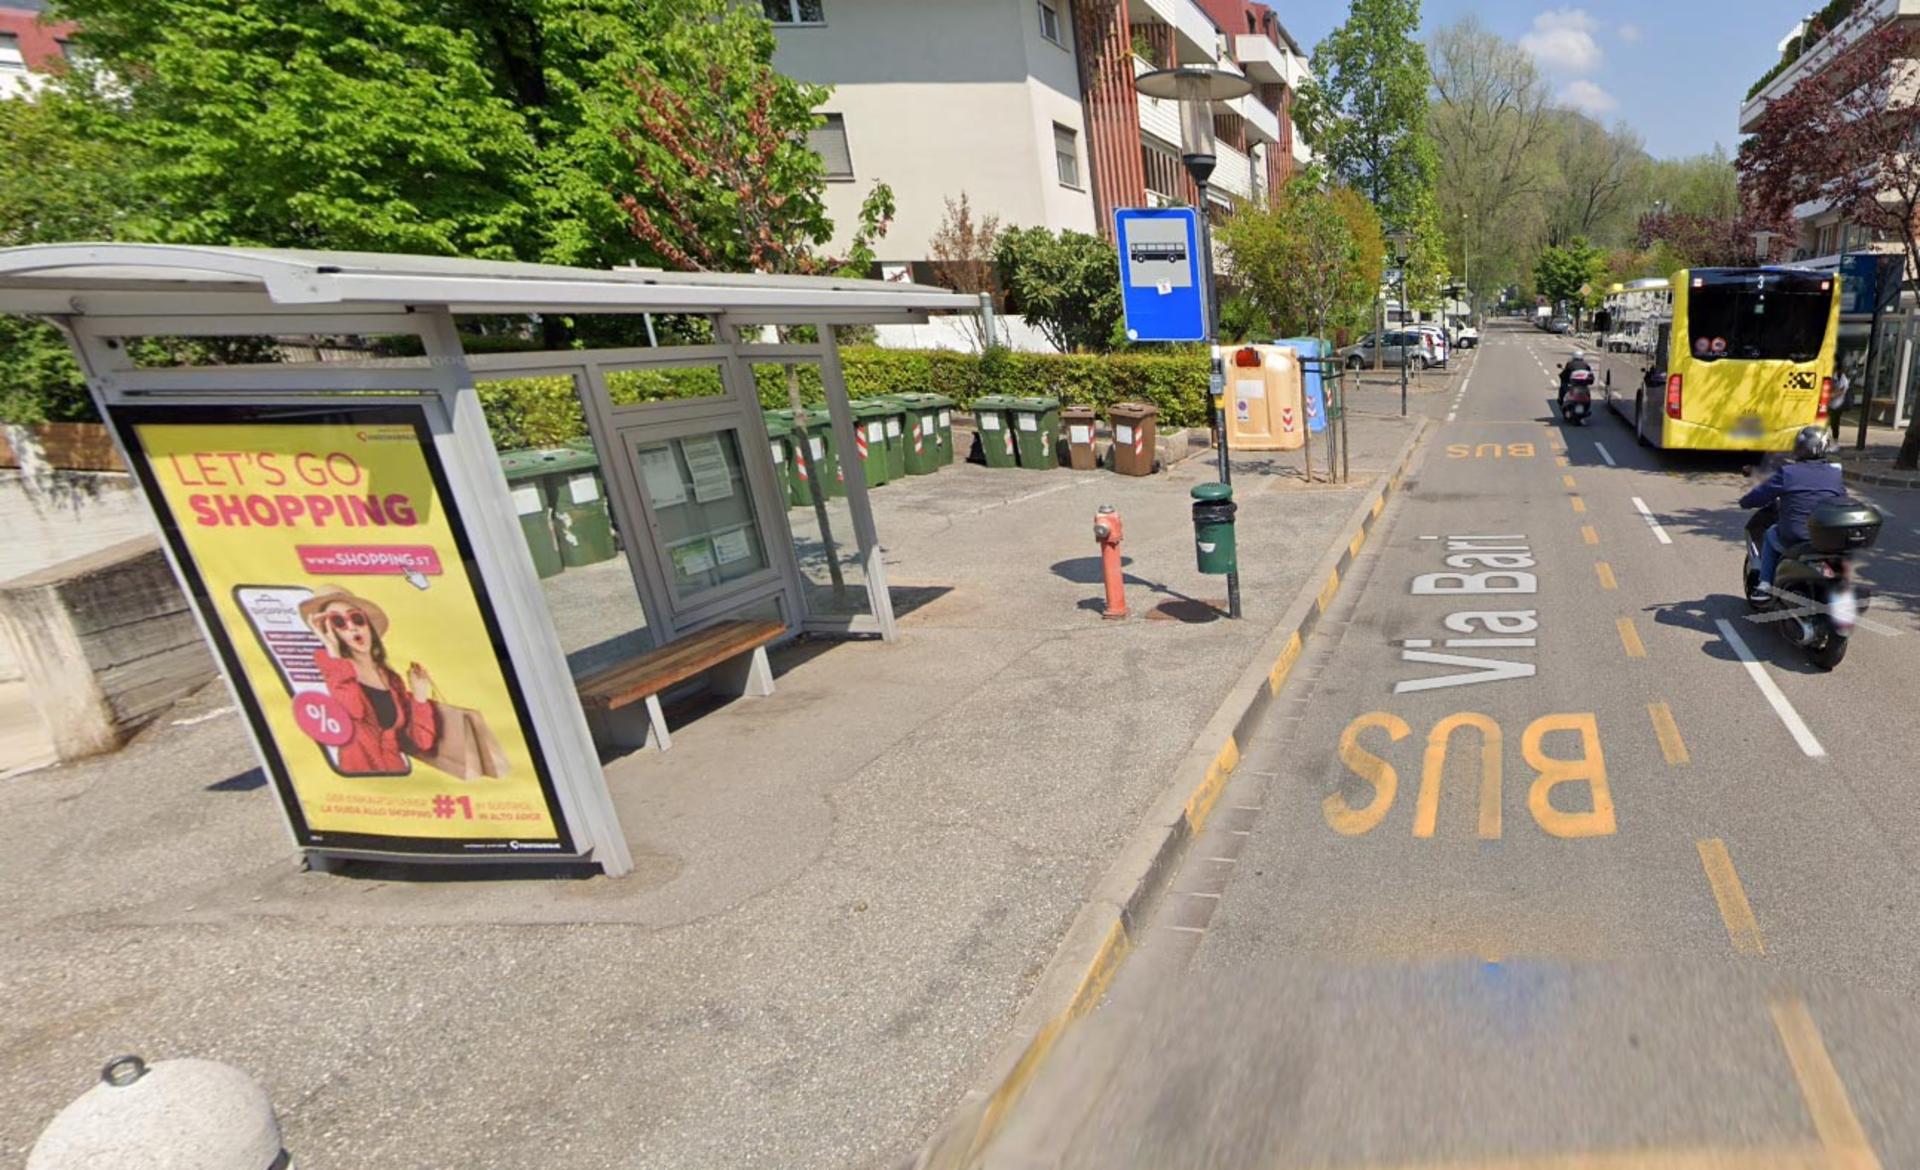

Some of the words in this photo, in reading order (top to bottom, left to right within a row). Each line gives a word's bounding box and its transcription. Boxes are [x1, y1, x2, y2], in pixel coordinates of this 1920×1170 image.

[1757, 275, 1766, 290] 3
[1445, 442, 1536, 459] BUS
[167, 452, 287, 487] LET'S
[294, 451, 362, 487] GO
[188, 494, 418, 527] SHOPPING
[1410, 532, 1538, 595] Bari
[1392, 608, 1538, 695] Via
[1321, 711, 1618, 840] BUS
[432, 794, 474, 820] #1
